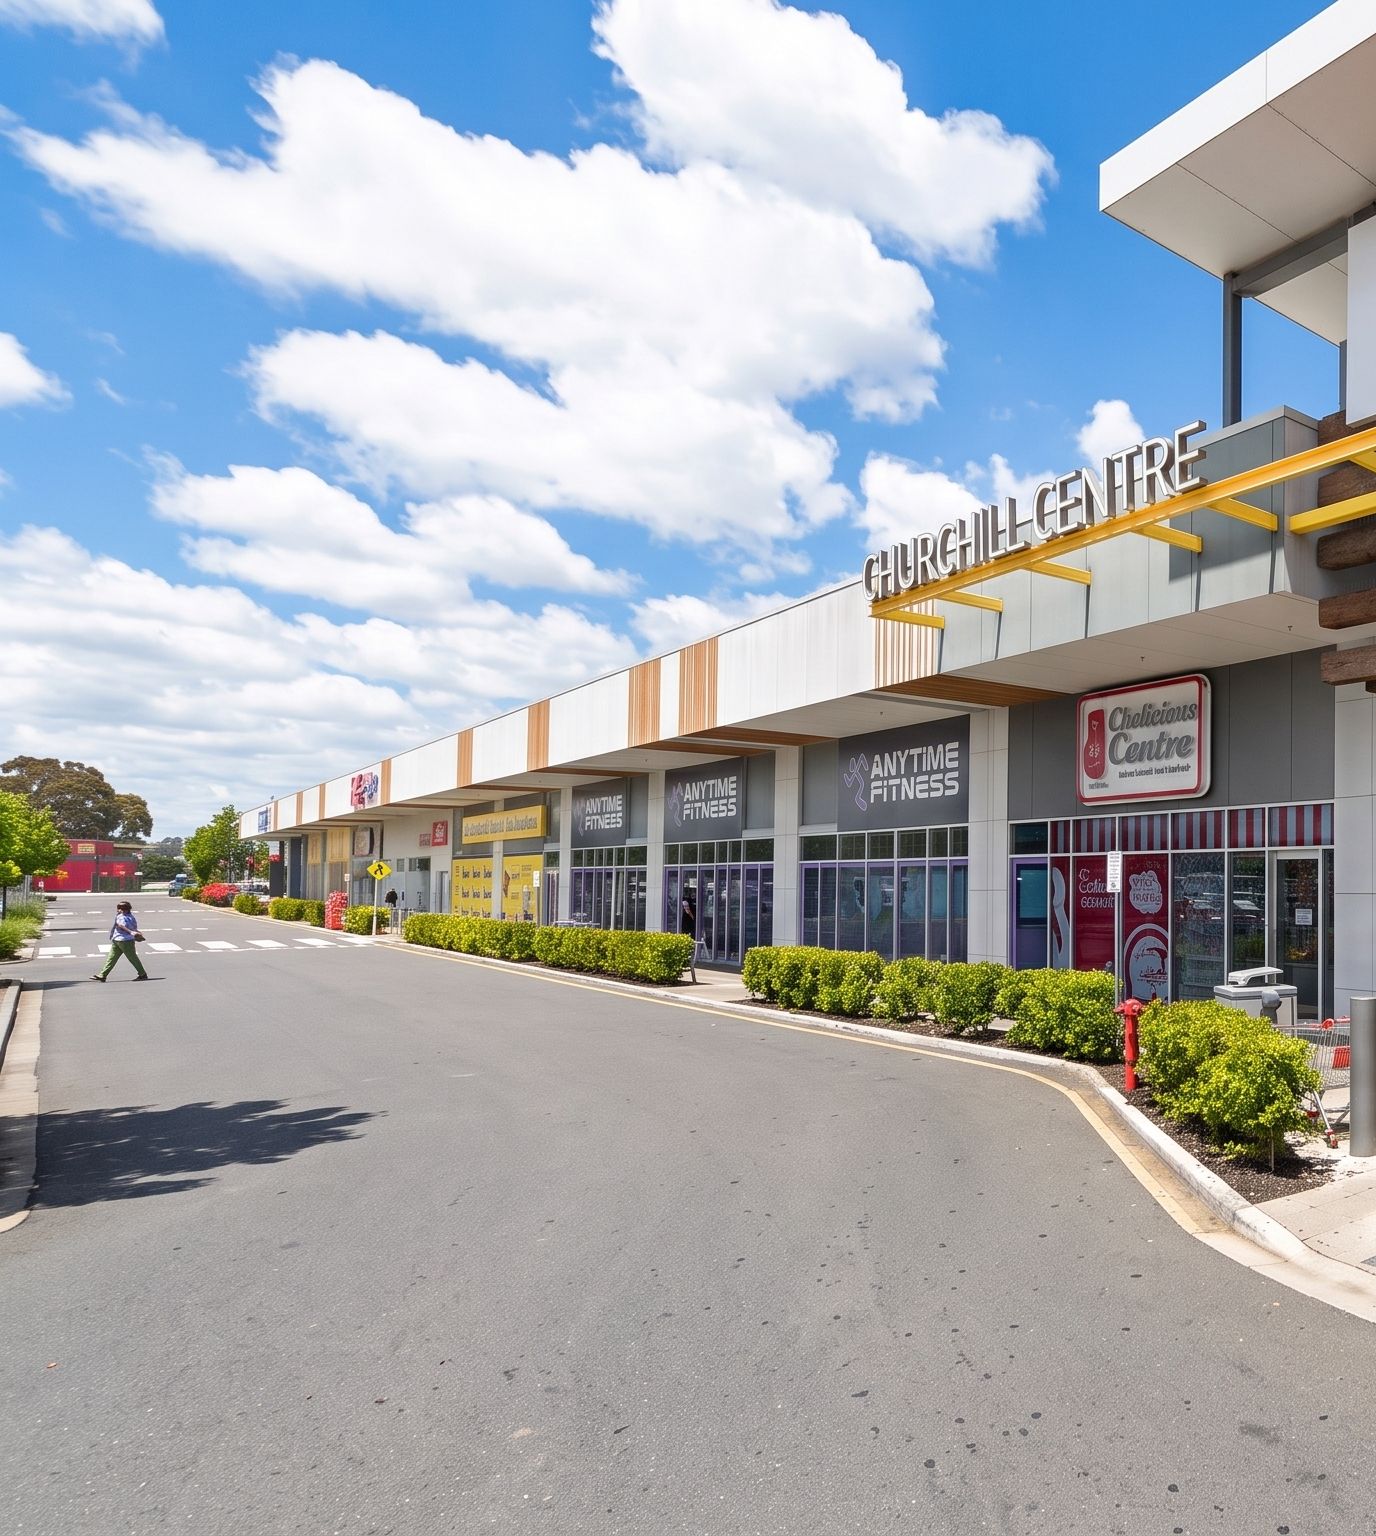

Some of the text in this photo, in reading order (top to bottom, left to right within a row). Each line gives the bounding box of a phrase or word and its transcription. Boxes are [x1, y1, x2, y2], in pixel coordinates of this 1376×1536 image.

[862, 420, 1208, 601] CHURCHILL CENTRE
[870, 741, 959, 779] ANYTIME
[1108, 731, 1194, 765] Centre
[684, 775, 737, 801] ANYTIME
[870, 770, 960, 803] FITNESS
[683, 798, 737, 821] FITNESS
